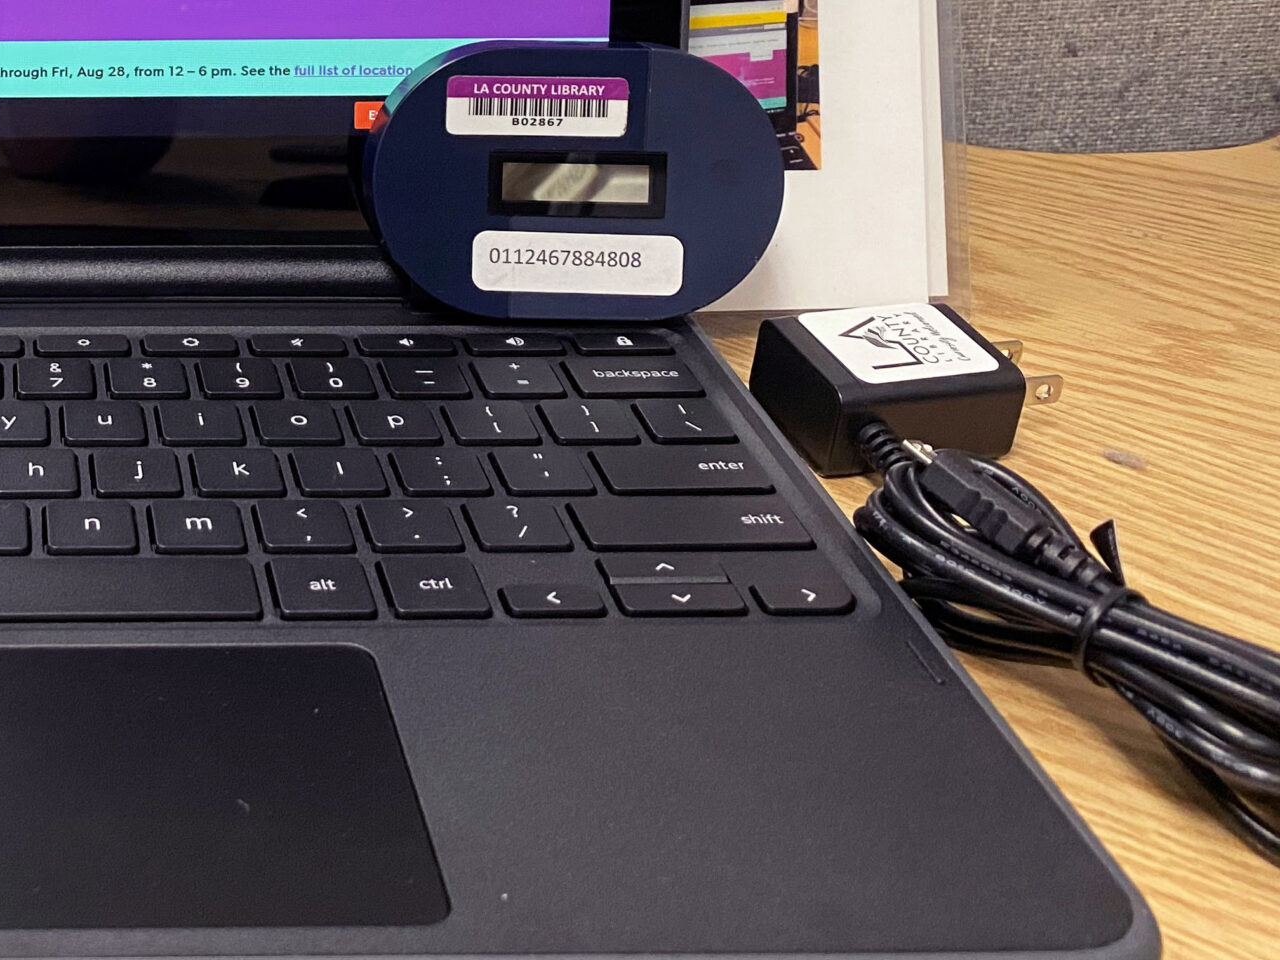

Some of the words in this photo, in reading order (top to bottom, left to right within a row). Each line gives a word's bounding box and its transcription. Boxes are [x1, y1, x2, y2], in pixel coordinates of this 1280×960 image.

[51, 66, 73, 79] Fri,
[76, 66, 104, 80] Aug
[108, 66, 130, 79] 28,
[133, 66, 165, 77] from
[168, 65, 184, 77] 12
[198, 65, 208, 77] 6
[211, 68, 237, 80] pm.
[240, 65, 266, 77] See
[268, 64, 291, 77] the
[294, 65, 315, 75] full
[319, 64, 338, 76] list
[341, 65, 356, 75] of
[359, 64, 416, 78] location
[473, 83, 490, 94] LA
[492, 83, 548, 95] COUNTY
[550, 84, 606, 96] LIBRARY
[511, 117, 564, 127] B02867
[488, 247, 642, 268] 0112467884808
[876, 315, 940, 364] COUNTY
[592, 369, 680, 379] backspace
[0, 415, 17, 430] y
[697, 460, 745, 471] enter
[740, 513, 784, 525] shift
[309, 578, 337, 591] alt
[419, 577, 454, 591] ctrl
